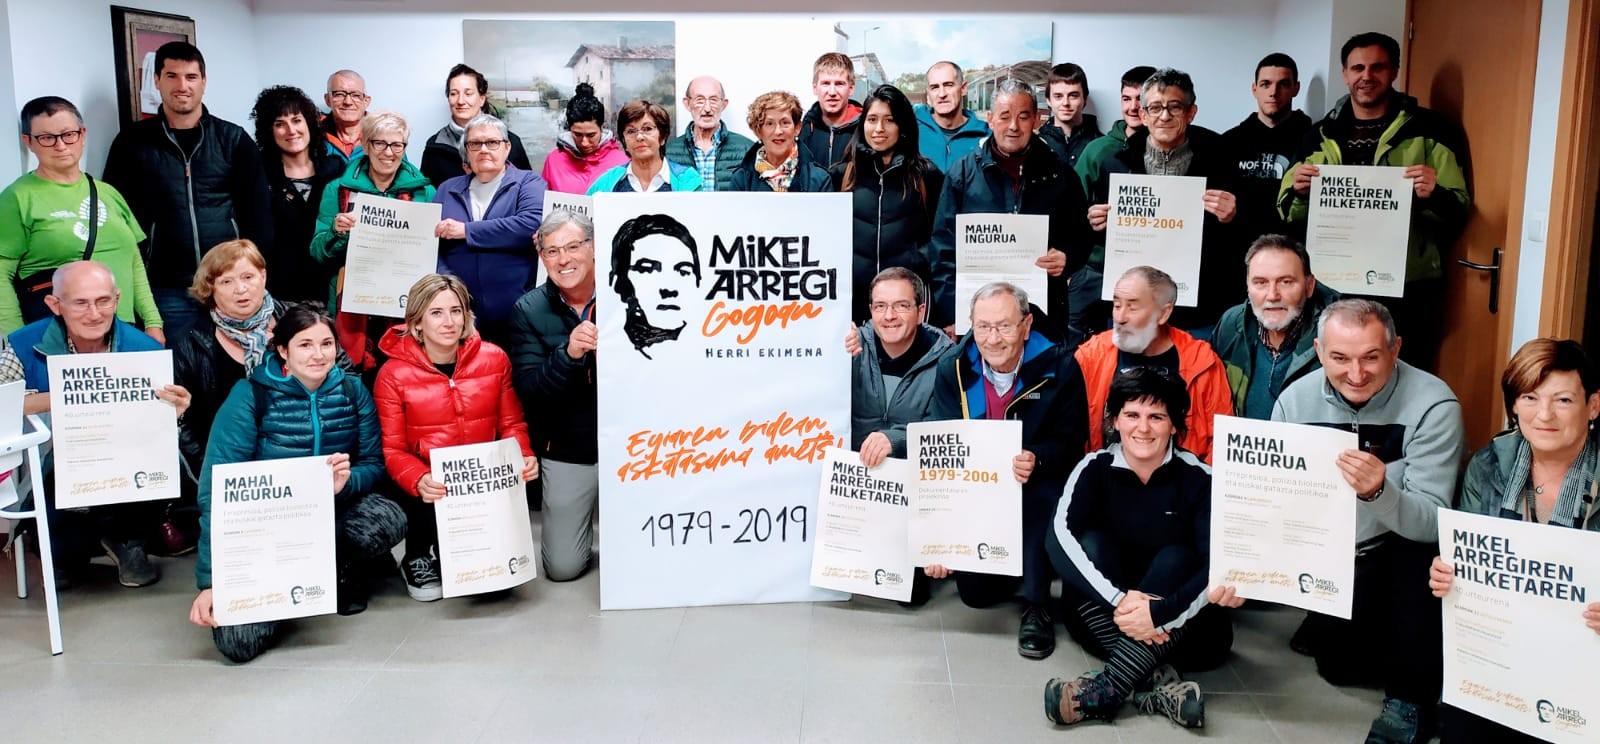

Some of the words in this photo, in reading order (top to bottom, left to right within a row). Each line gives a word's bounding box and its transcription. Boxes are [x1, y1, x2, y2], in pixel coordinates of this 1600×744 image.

[1321, 176, 1360, 188] MIKEL
[1118, 185, 1155, 196] MIKEL
[1320, 187, 1392, 199] ARREGIREN
[1118, 196, 1161, 207] ARREGI
[1320, 198, 1398, 210] HILKETAREN
[362, 204, 396, 219] MAHAI
[1117, 206, 1156, 218] MARIN
[360, 214, 410, 230] INGURUA
[965, 224, 1002, 234] MAHAI
[1116, 217, 1184, 230] 1979-2004
[965, 234, 1016, 244] INGURUA
[705, 268, 837, 301] ARREGI
[706, 348, 750, 358] HERRI
[759, 348, 823, 358] EKIMENA
[62, 366, 112, 380] MIKEL
[63, 378, 151, 392] ARREGIREN
[64, 389, 160, 406] HILKETAREN
[919, 434, 964, 446] MIKEL
[1227, 433, 1284, 454] MAHAI
[919, 446, 970, 458] ARREGI
[1227, 448, 1308, 471] INGURUA
[442, 458, 484, 472] MIKEL
[832, 460, 872, 478] MIKEL
[919, 458, 965, 470] MARIN
[224, 474, 273, 490] MAHAI
[444, 464, 514, 485] ARREGIREN
[920, 469, 999, 484] 1979-2004
[445, 474, 519, 497] HILKETAREN
[830, 473, 904, 494] ARREGIREN
[224, 486, 293, 503] INGURUA
[830, 484, 909, 508] HILKETAREN
[641, 506, 808, 547] 1979-2019
[1452, 528, 1516, 556] MIKEL
[1452, 546, 1574, 583] ARREGIREN
[1454, 562, 1586, 604] HILKETAREN
